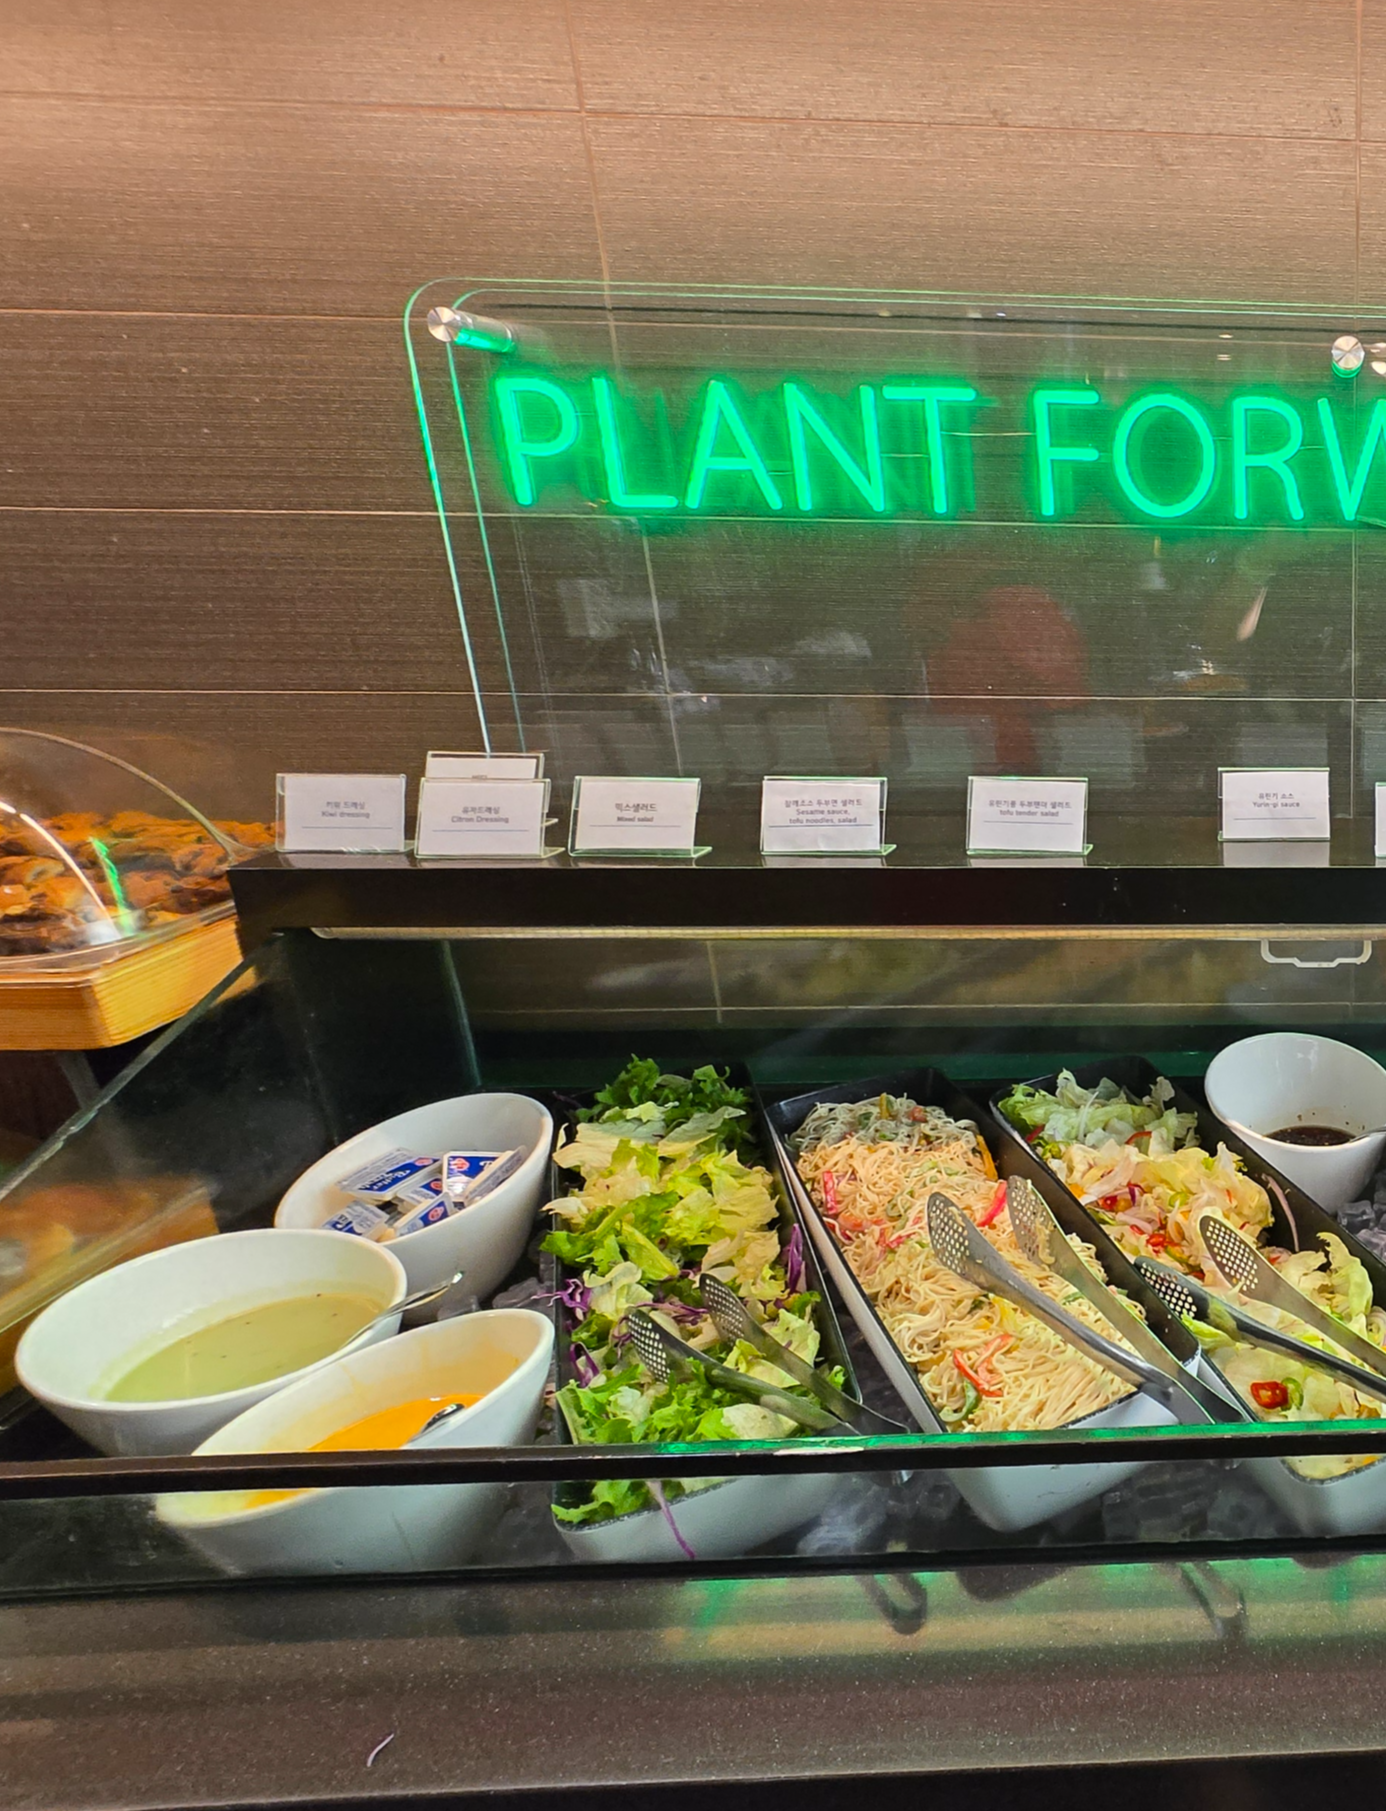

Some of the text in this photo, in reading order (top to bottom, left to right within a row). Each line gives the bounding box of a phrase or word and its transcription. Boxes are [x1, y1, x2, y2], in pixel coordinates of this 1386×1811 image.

[495, 376, 977, 513] PLANT
[816, 799, 838, 807] 두부면
[840, 798, 863, 807] 샐러드
[1050, 801, 1073, 809] 샐러드
[615, 803, 658, 813] 믹스샐러드
[796, 808, 826, 816] Sesame
[339, 811, 371, 820] dressing
[476, 815, 510, 824] Dressing
[838, 816, 858, 824] salad
